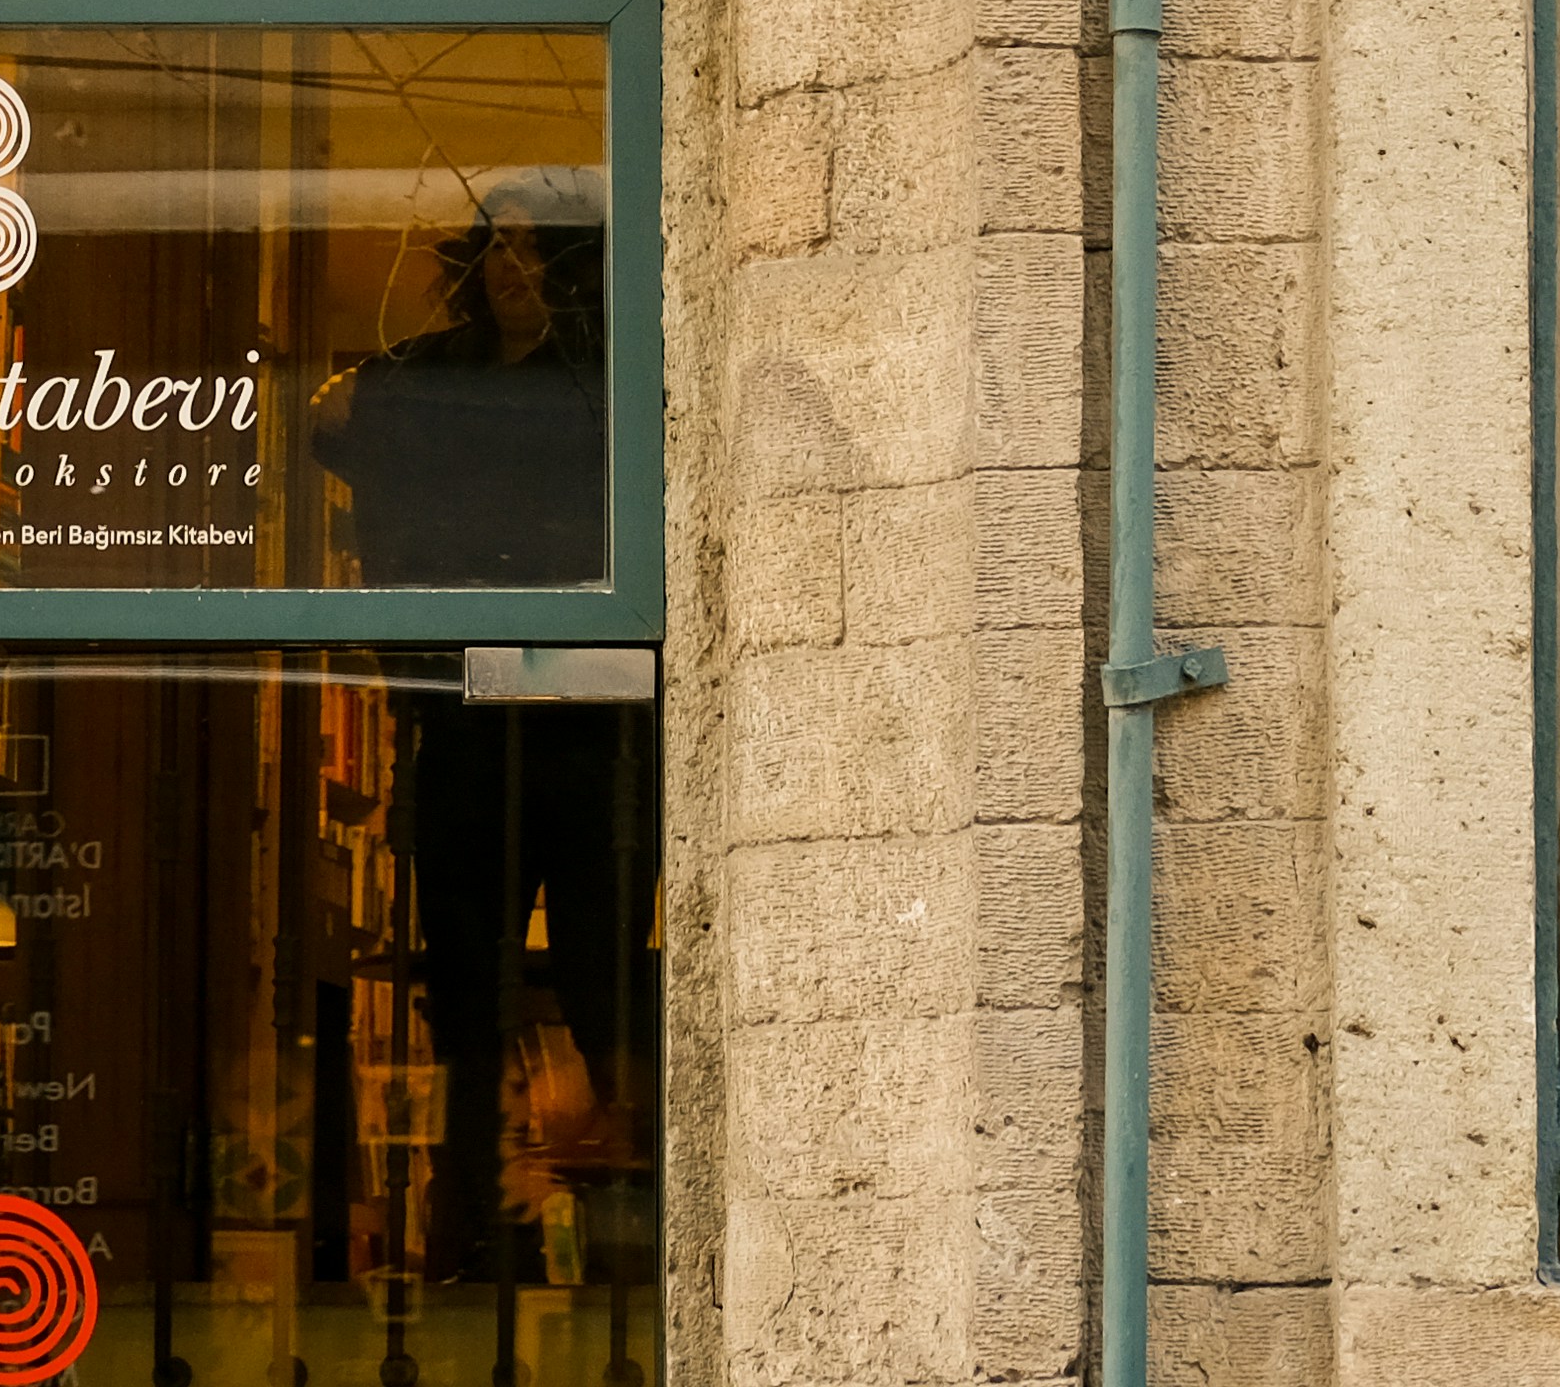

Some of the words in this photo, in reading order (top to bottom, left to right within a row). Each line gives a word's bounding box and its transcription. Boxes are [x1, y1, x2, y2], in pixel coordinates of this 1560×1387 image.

[21, 525, 62, 546] Beri
[68, 524, 163, 551] Bağımsız
[168, 524, 254, 546] Kitabevi
